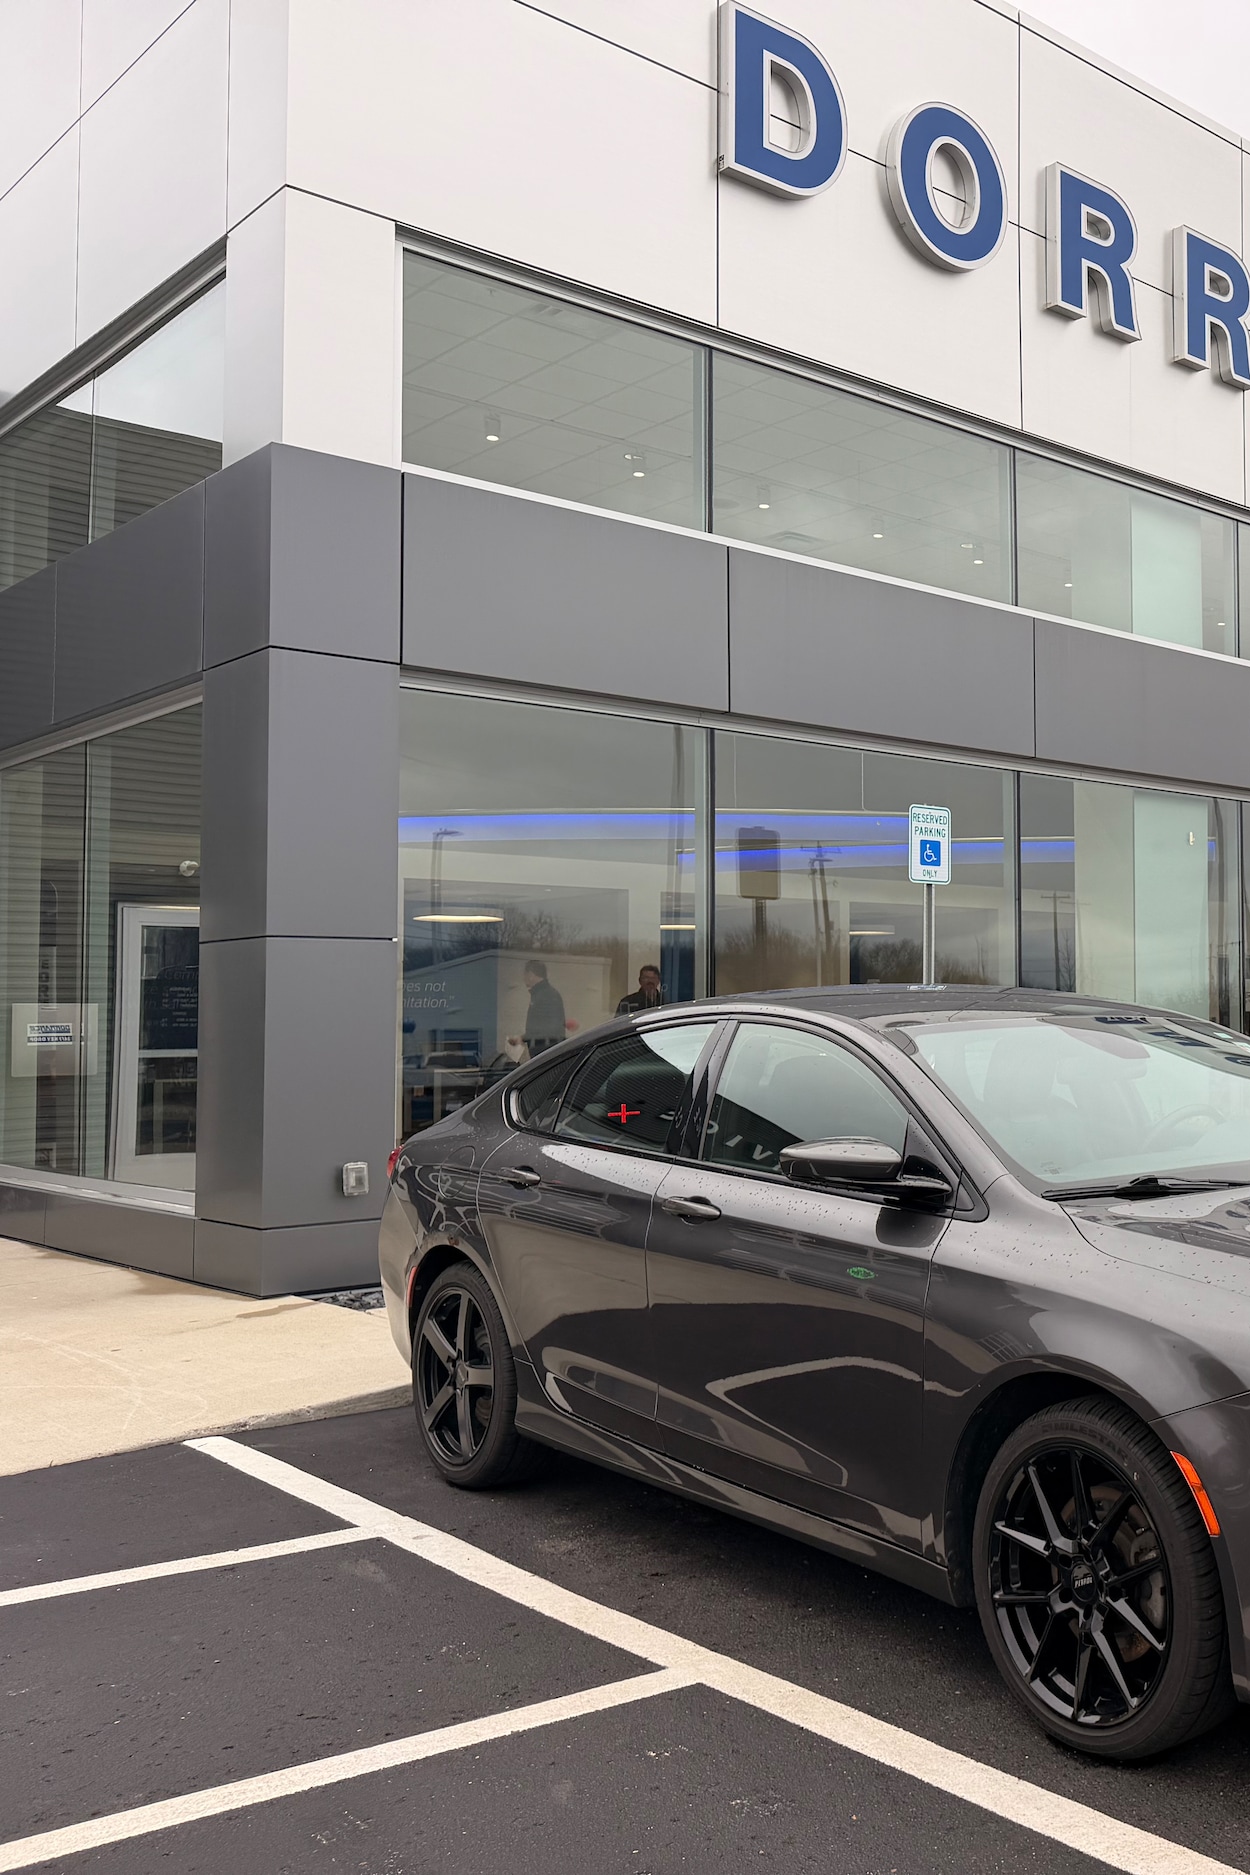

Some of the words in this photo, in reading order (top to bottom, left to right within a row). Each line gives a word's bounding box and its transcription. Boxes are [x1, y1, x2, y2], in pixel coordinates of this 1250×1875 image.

[912, 812, 948, 826] RESERVED
[914, 826, 946, 838] PARKING
[922, 869, 938, 878] ONLY
[425, 980, 446, 992] not
